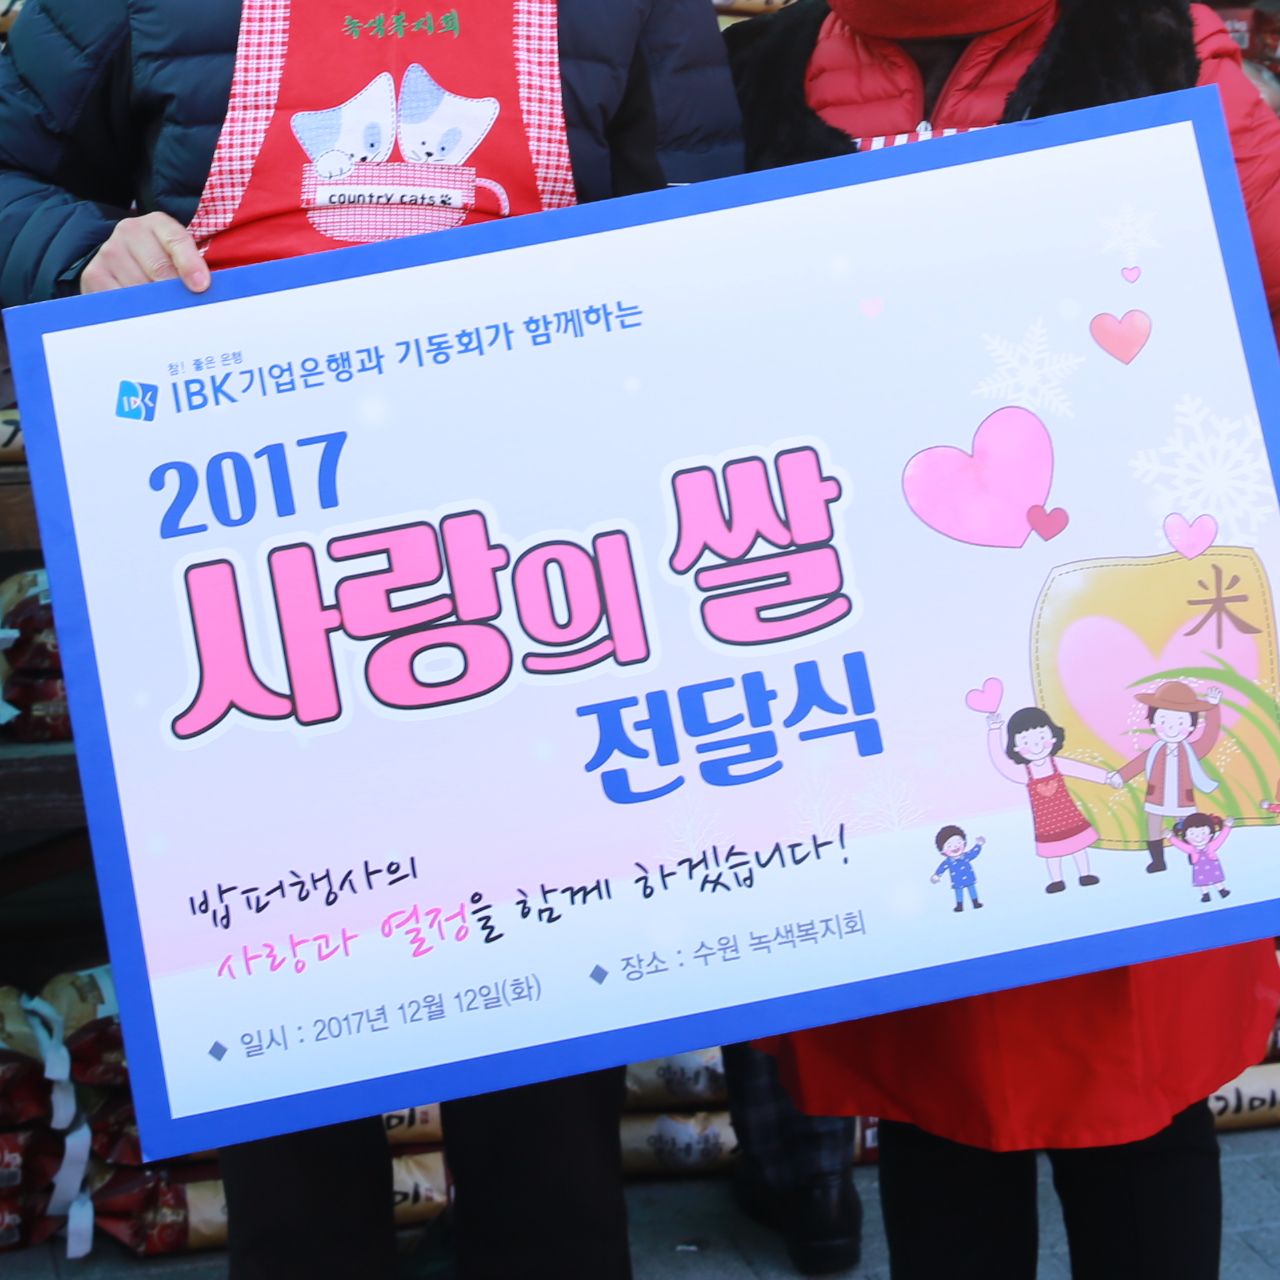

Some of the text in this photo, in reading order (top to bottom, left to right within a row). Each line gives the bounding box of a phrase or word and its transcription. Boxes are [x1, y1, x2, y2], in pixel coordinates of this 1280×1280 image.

[341, 9, 460, 40] 녹색복지회
[328, 191, 437, 206] country cats
[171, 300, 644, 414] IBK기업은행과 기동회가 함께하는
[192, 355, 217, 372] 좋은
[220, 350, 244, 368] 은행
[148, 430, 349, 539] 2017
[170, 444, 854, 741] 사랑의 쌀
[1183, 563, 1263, 650] 米
[576, 650, 885, 805] 전달식
[189, 856, 418, 930] 밥퍼행사의
[217, 822, 849, 980] 사랑과 열정을 함께 하겠습니다!
[620, 950, 670, 982] 장소
[692, 933, 742, 968] 수원
[747, 908, 868, 955] 녹색복지회
[240, 1024, 290, 1059] 일시
[312, 1004, 390, 1042] 2017년
[397, 992, 447, 1025] 12월
[453, 973, 542, 1013] 12일(화)
[1214, 1087, 1277, 1116] 기미
